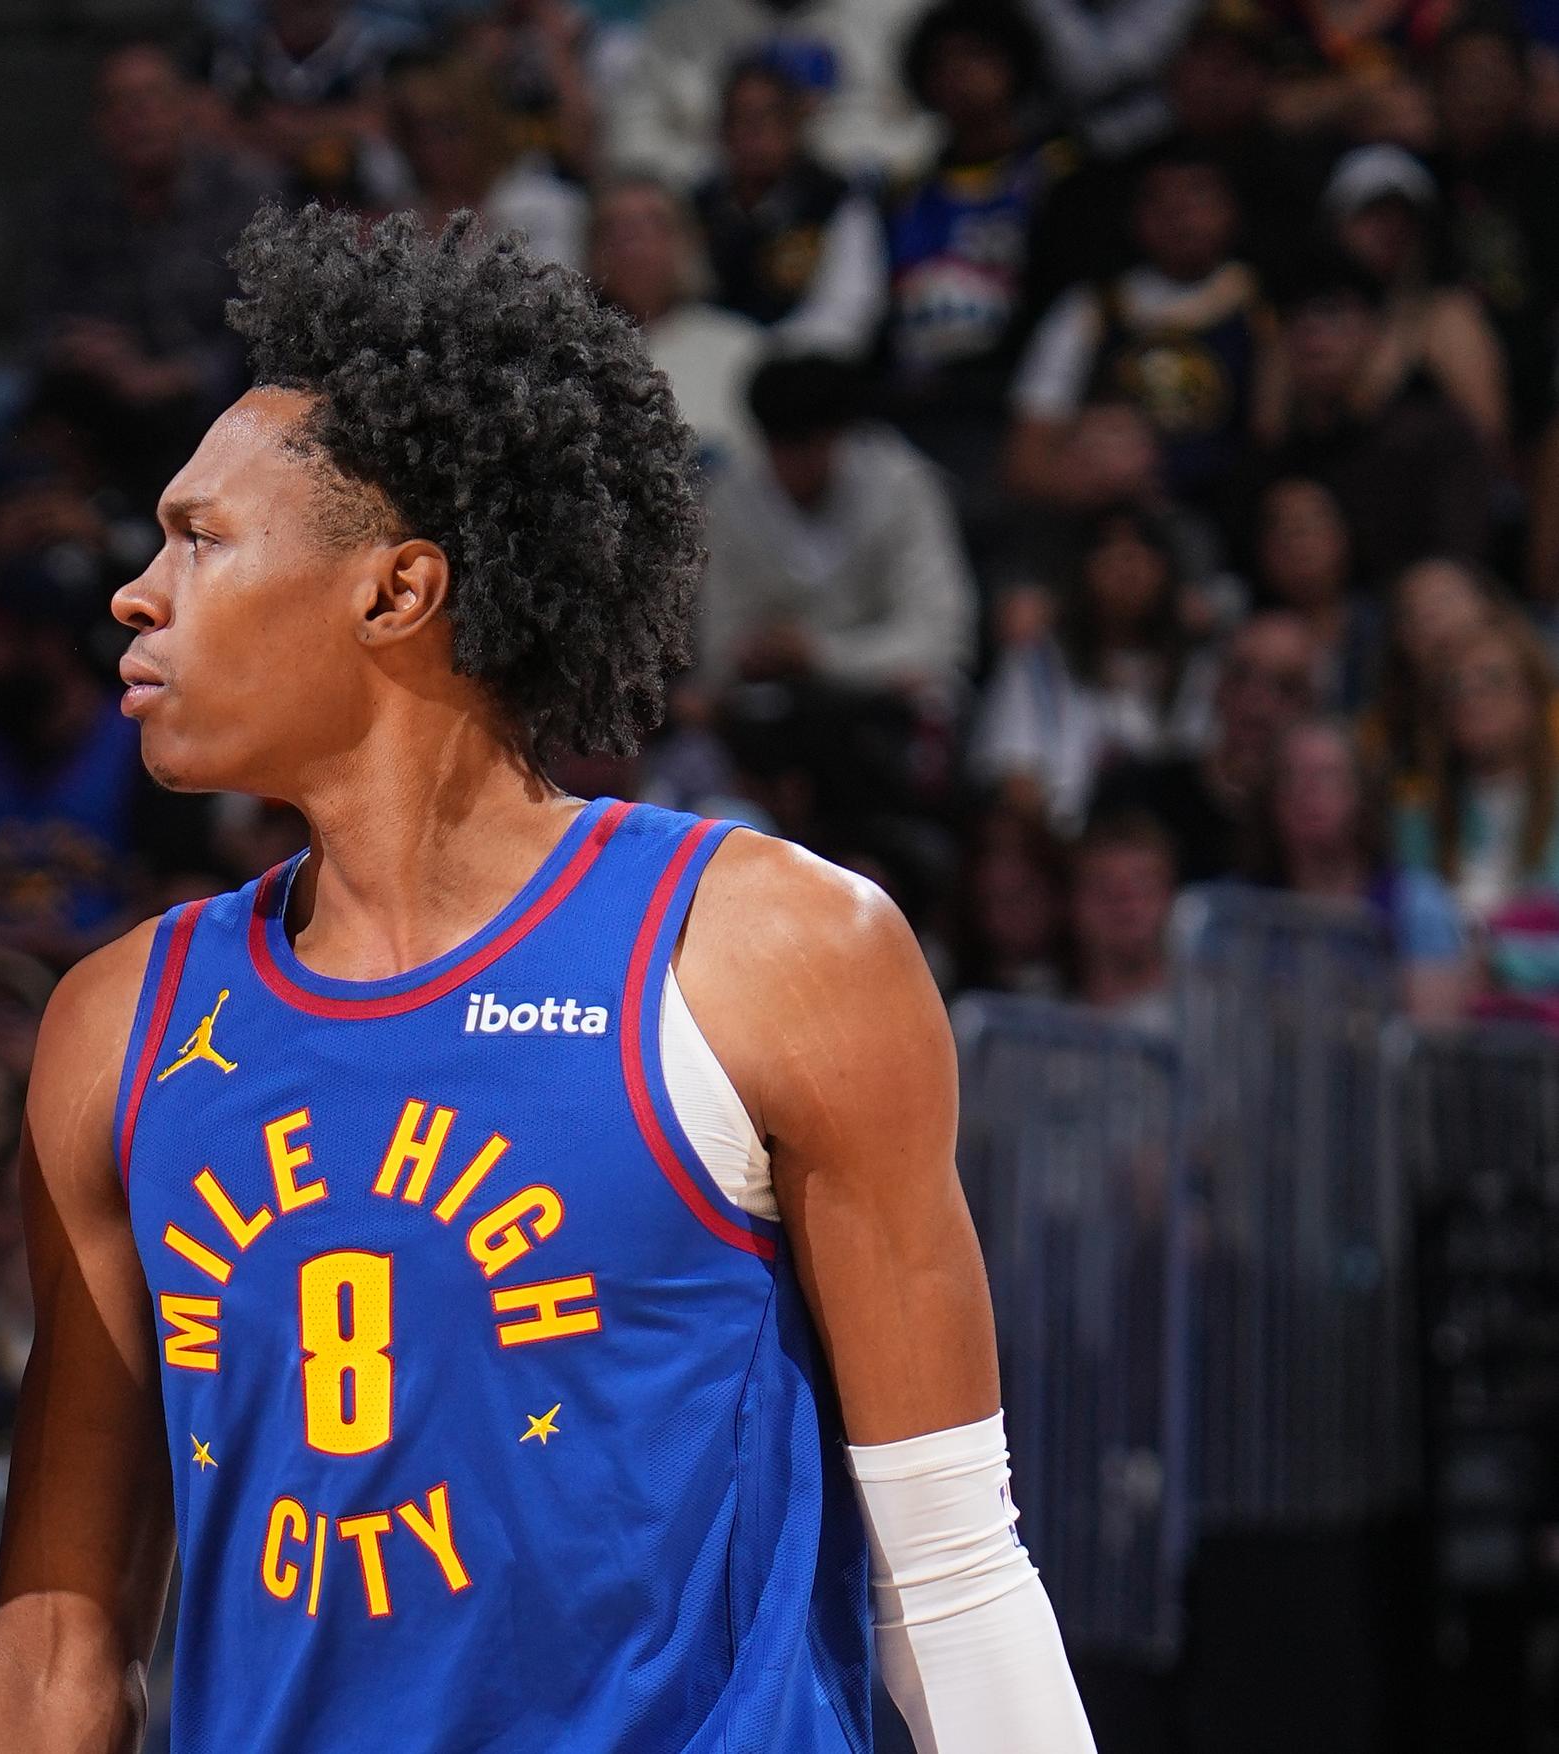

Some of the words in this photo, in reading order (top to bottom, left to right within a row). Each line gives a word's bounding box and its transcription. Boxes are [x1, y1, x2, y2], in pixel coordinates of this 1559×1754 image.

[464, 993, 608, 1036] ibotta
[159, 1108, 328, 1373] MILE
[372, 1098, 601, 1349] HIGH
[299, 1248, 394, 1455] 8
[260, 1482, 474, 1618] CITY
